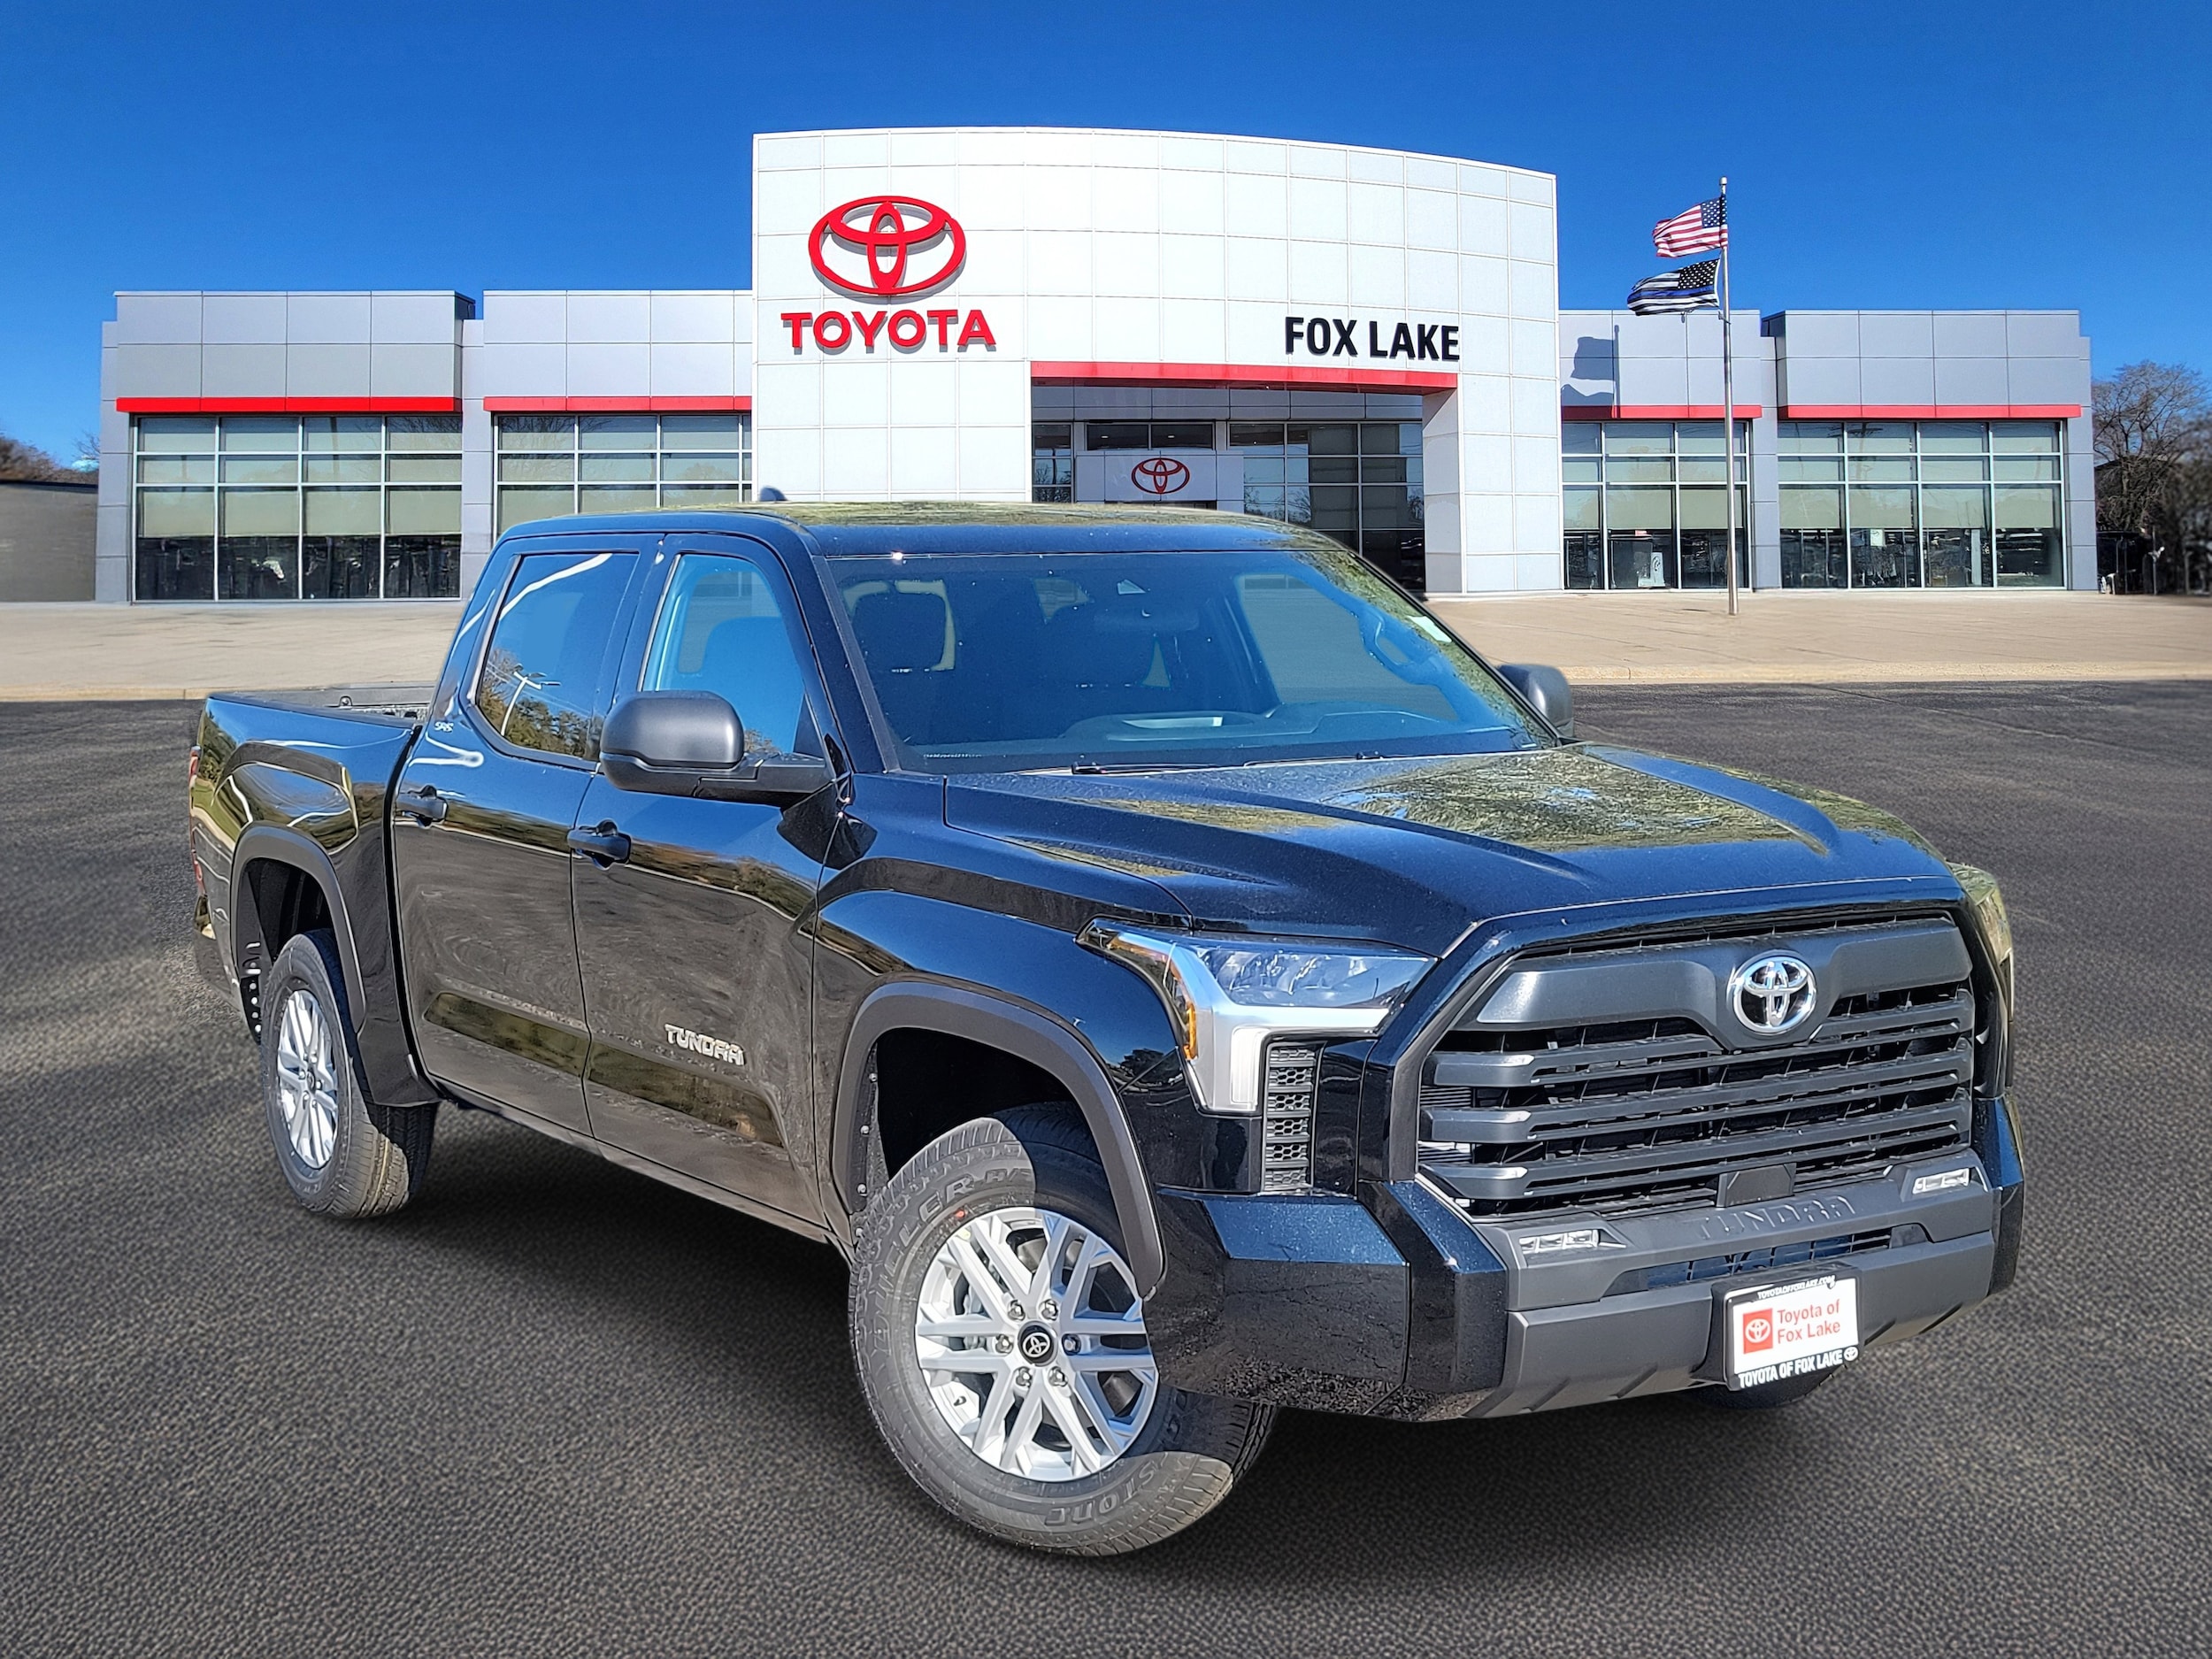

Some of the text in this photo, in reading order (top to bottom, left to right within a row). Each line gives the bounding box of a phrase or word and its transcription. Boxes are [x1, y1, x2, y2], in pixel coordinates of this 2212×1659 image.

[780, 310, 996, 349] TOYOTA
[1286, 317, 1460, 361] FOX LAKE
[664, 1023, 745, 1065] TUNDRA
[1685, 1195, 1856, 1239] TUNDRA
[1777, 1299, 1840, 1325] Toyota of
[1777, 1320, 1840, 1344] Fox Lake
[1738, 1348, 1844, 1389] TOYOTA OF FOX LAKE
